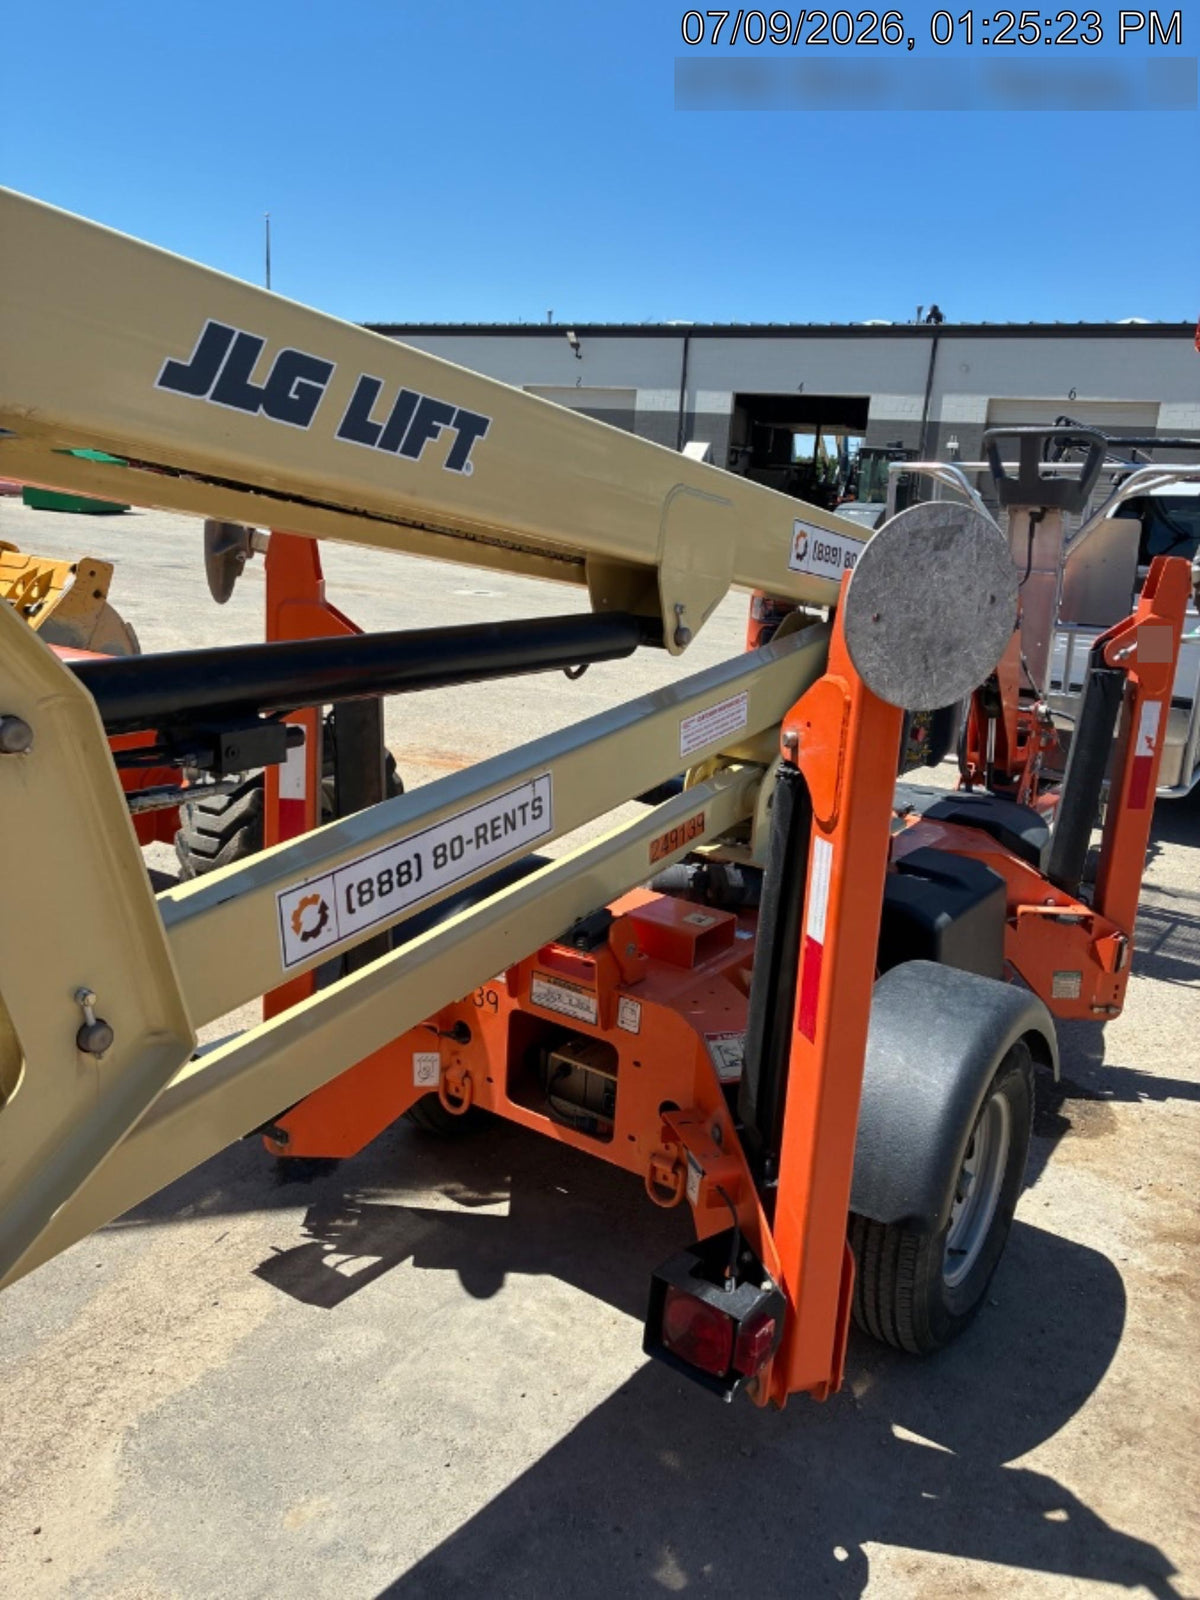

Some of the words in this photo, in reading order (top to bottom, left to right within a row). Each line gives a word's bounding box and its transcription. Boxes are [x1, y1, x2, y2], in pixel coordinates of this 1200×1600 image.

[154, 318, 337, 431] JLG
[335, 372, 493, 475] LIFT
[1068, 386, 1077, 401] 6
[812, 539, 842, 569] (888)
[345, 853, 424, 915] (888)
[431, 796, 544, 870] 80-RENTS
[650, 811, 705, 864] 249139
[464, 986, 499, 1014] 39
